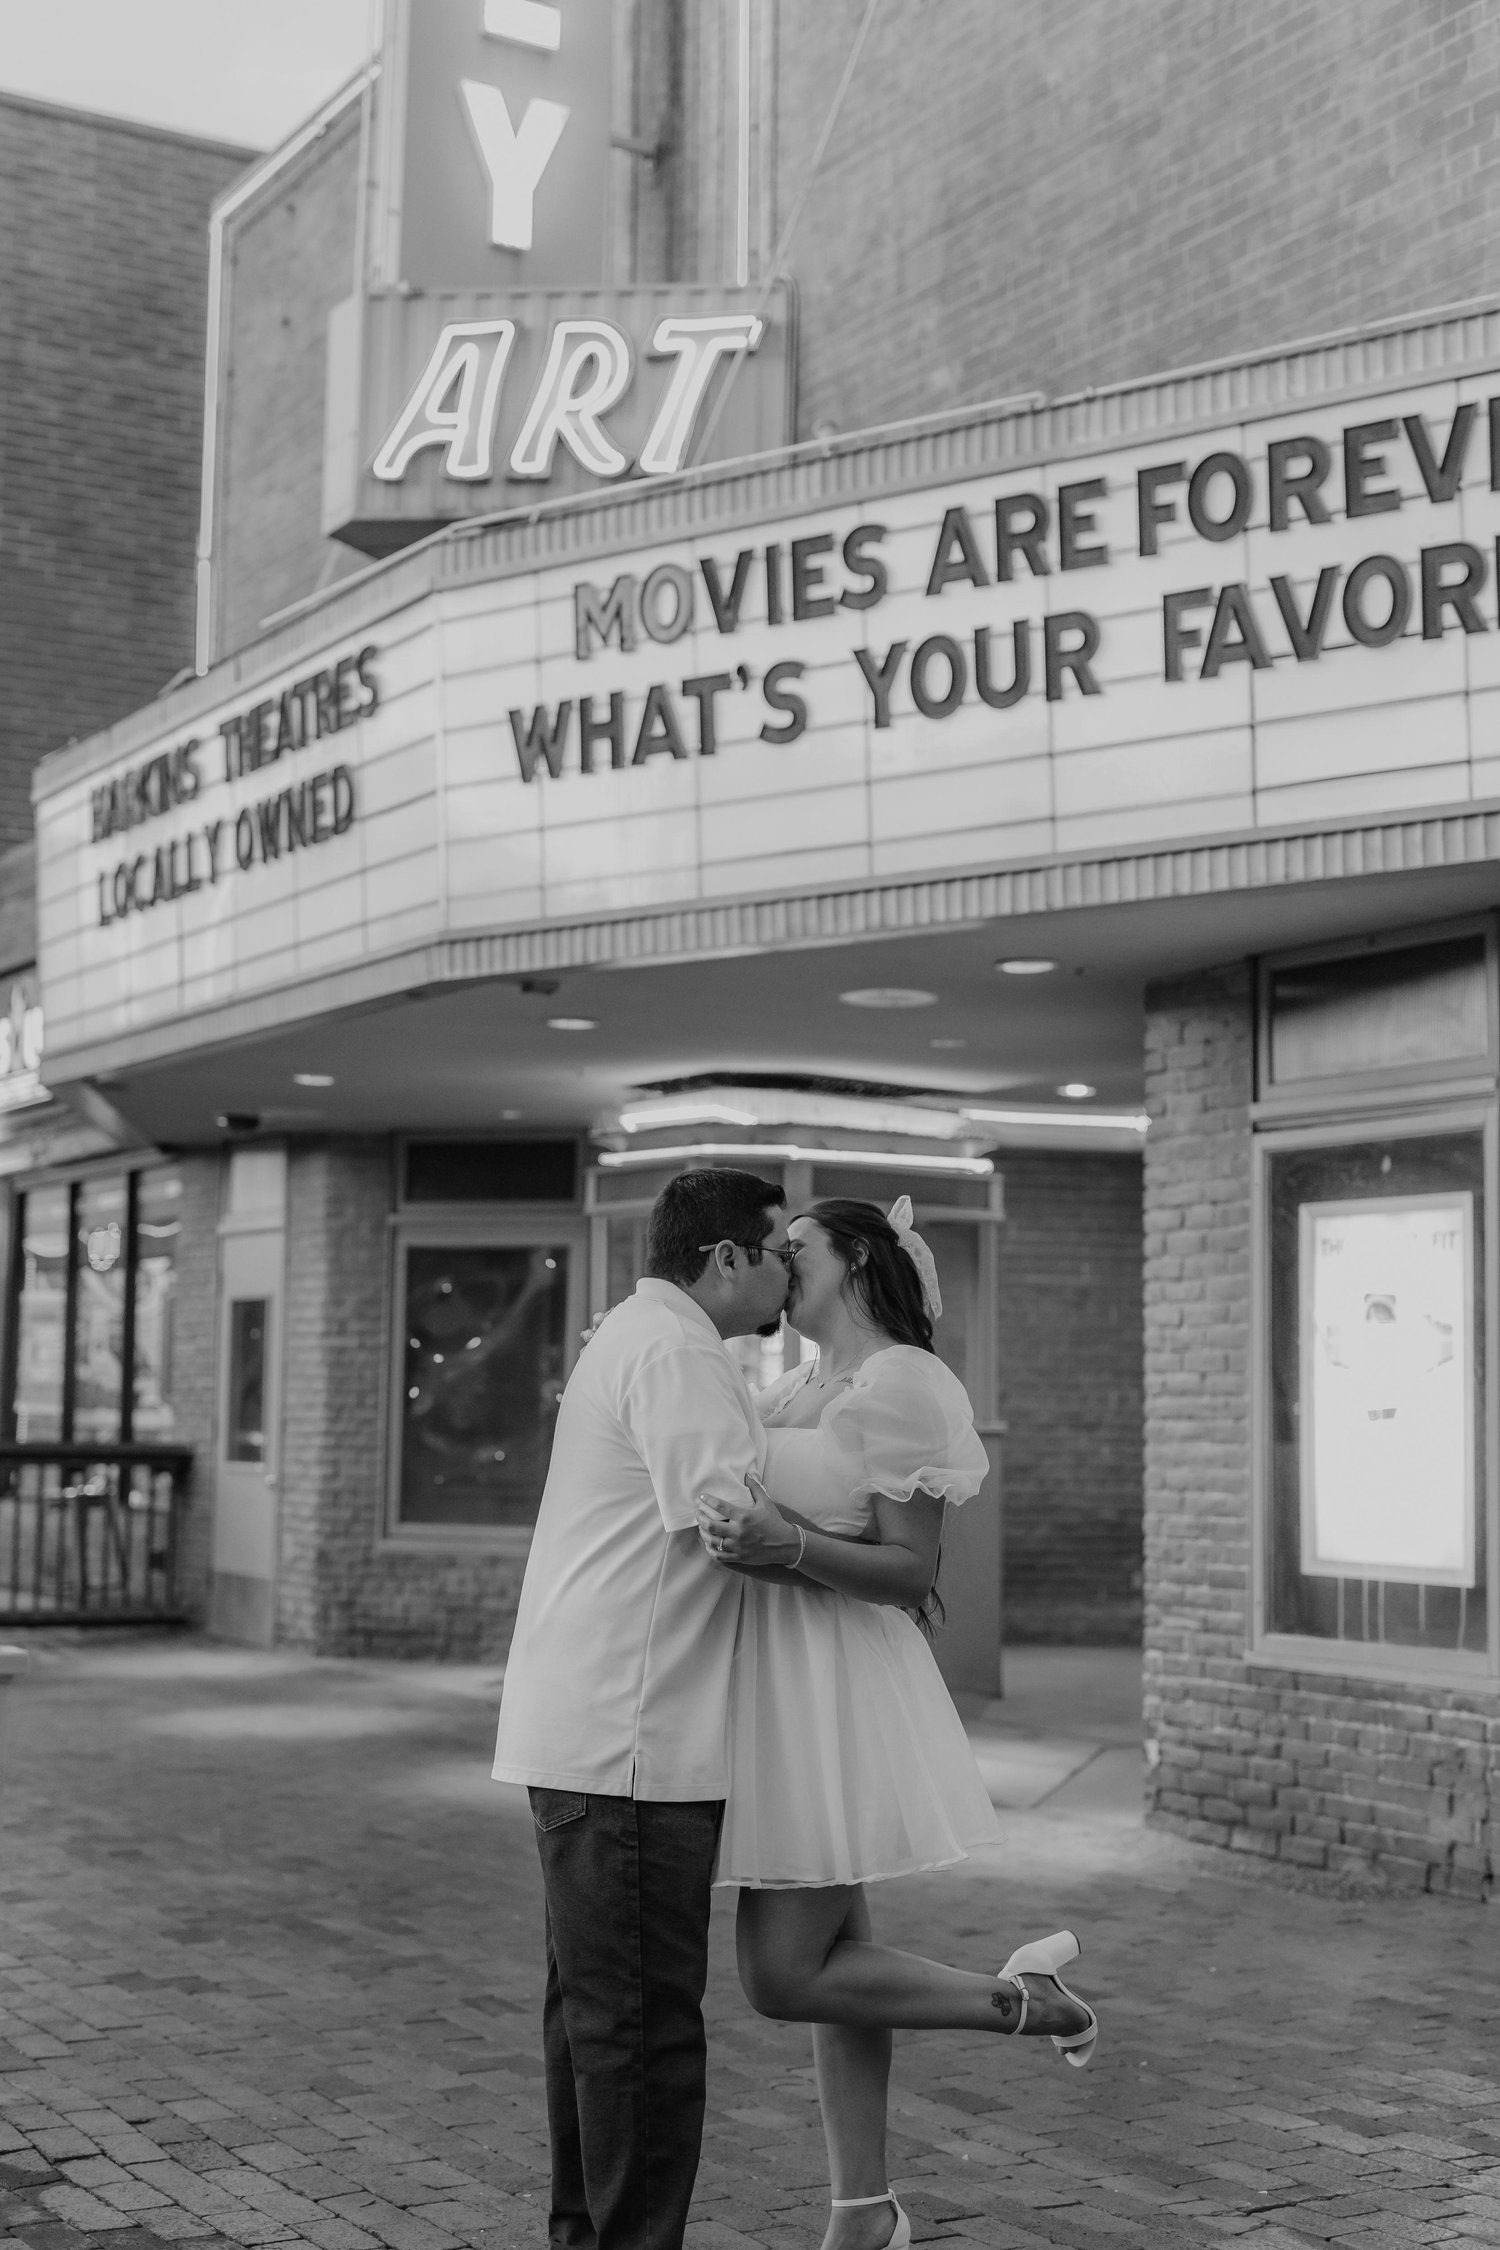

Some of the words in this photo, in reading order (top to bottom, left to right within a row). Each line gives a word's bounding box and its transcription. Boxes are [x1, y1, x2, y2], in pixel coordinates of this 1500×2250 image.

[370, 315, 764, 481] ART
[573, 524, 888, 660] MOVIES
[925, 477, 1109, 596] ARE
[1137, 396, 1500, 557] FOREV
[219, 645, 380, 783] THEATRES
[508, 660, 808, 783] WHAT'S
[853, 610, 1103, 730] YOUR
[1162, 535, 1500, 683] FAVOR
[97, 819, 223, 927] LOCALLY
[236, 764, 356, 871] OWNED
